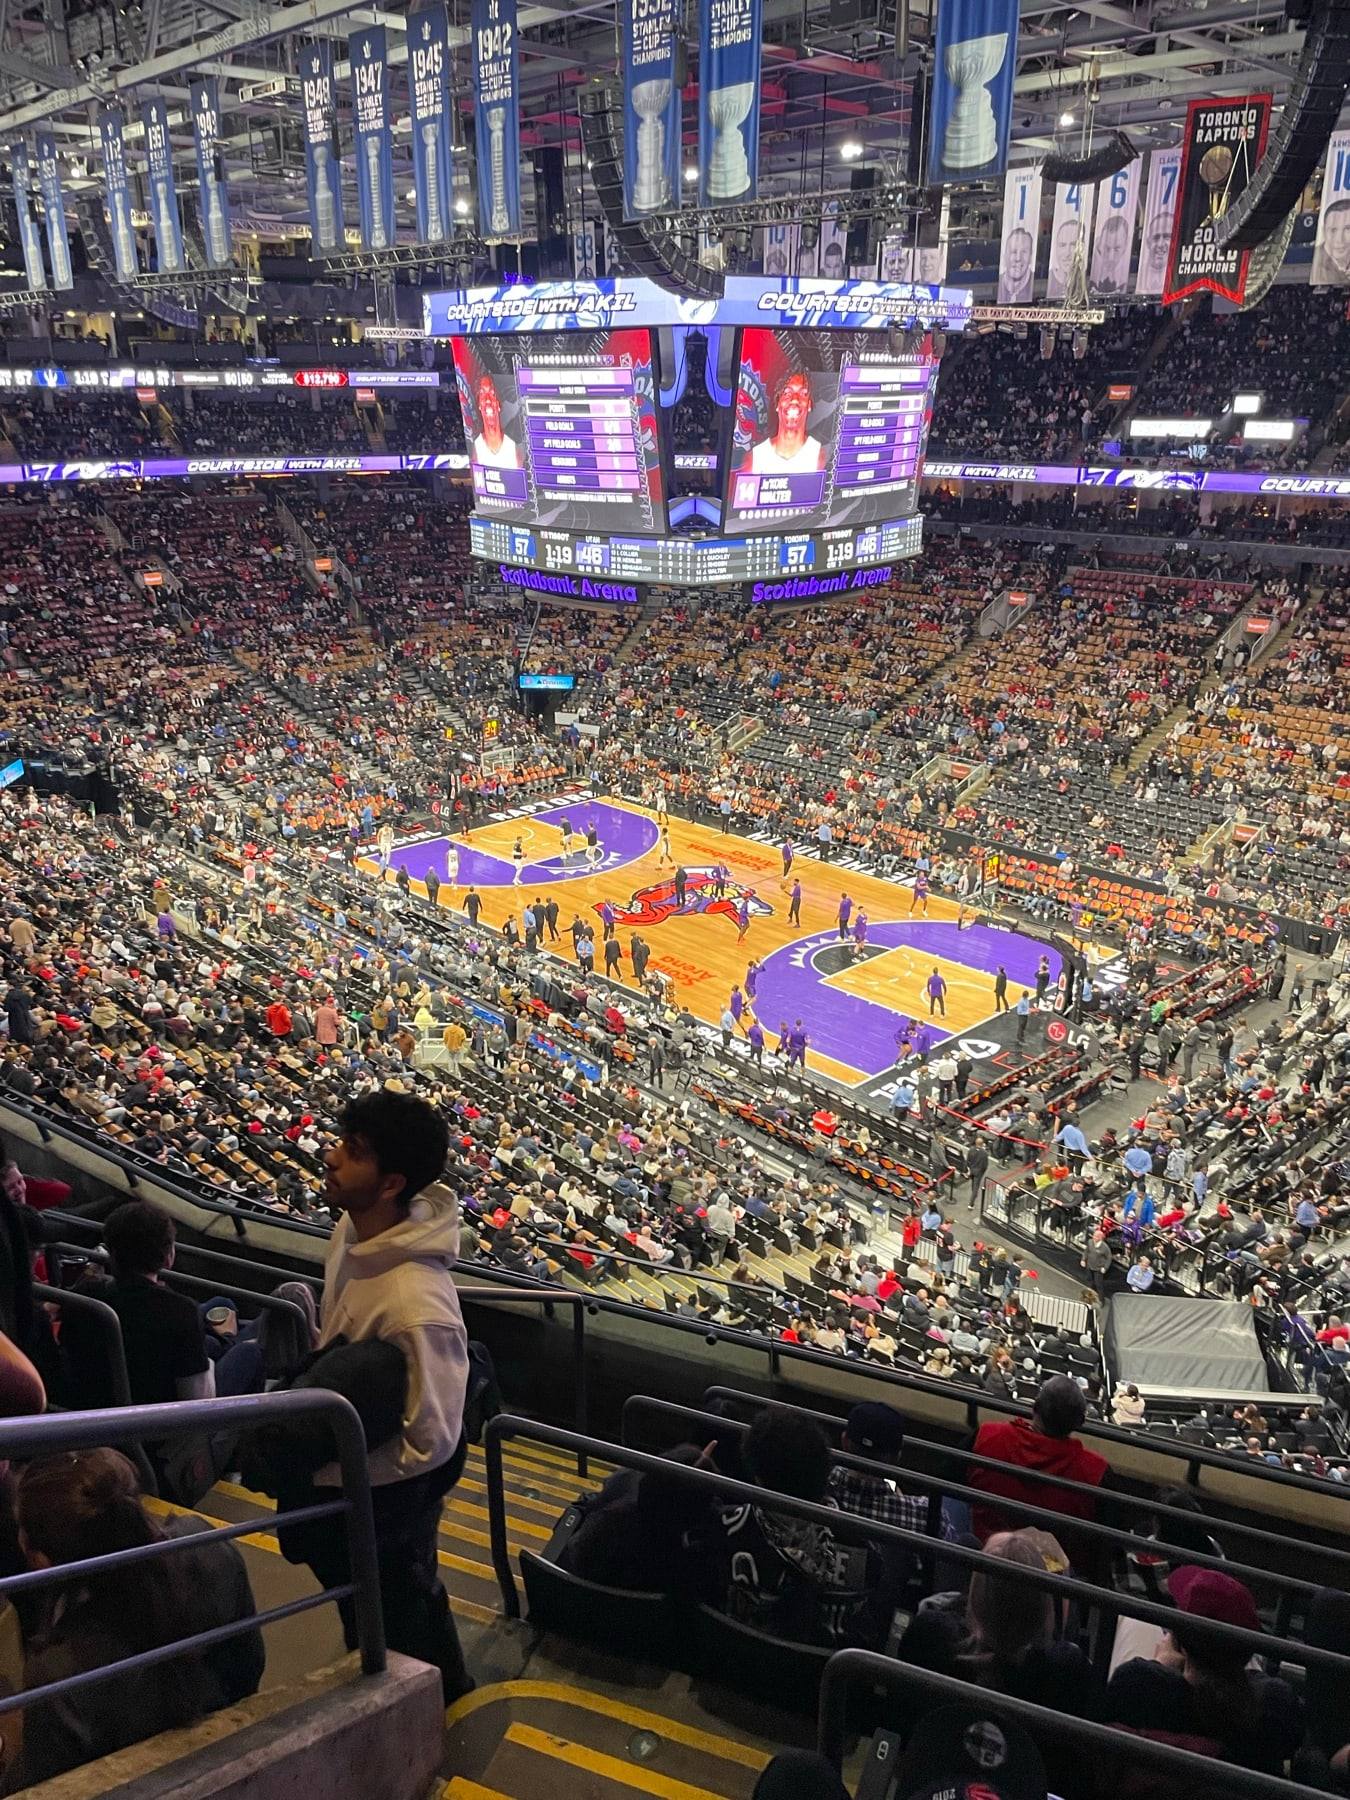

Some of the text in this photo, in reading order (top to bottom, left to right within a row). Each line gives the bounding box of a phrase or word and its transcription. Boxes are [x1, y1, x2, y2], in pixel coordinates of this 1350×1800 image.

[721, 15, 739, 32] CUP
[477, 22, 512, 62] 1942
[643, 33, 660, 50] CUP
[711, 28, 752, 49] CHAMPIONS
[413, 41, 443, 80] 1945
[632, 47, 671, 66] CHAMPIONS
[355, 61, 383, 95] 1947
[480, 59, 510, 79] STANLEY
[488, 76, 503, 90] CUP
[1199, 109, 1257, 127] TORONTO
[1196, 125, 1255, 143] RAPTORS
[1110, 171, 1128, 209] 6
[1161, 166, 1178, 205] 7
[1019, 184, 1027, 220] 1
[1065, 184, 1080, 212] 4
[1181, 244, 1238, 263] WORLD
[1178, 262, 1236, 275] CHAMPIONS
[447, 293, 636, 321] COURTSIDE WITH AKIL
[187, 459, 362, 472] COURTSIDE WITH AKIL
[675, 457, 709, 466] AKIL
[965, 467, 997, 476] WITH
[996, 468, 1037, 479] AKIL
[515, 537, 529, 555] 57
[546, 544, 572, 565] 1:19
[788, 545, 807, 565] 57
[827, 542, 854, 562] 1:19
[861, 536, 877, 554] 46
[581, 546, 603, 565] 46
[500, 564, 638, 602] Scotiabank Arena
[752, 566, 892, 603] Scotiabank Arena
[440, 805, 450, 817] LG
[732, 850, 777, 866] Arena
[660, 956, 717, 981] Arena
[1067, 1030, 1090, 1050] LG
